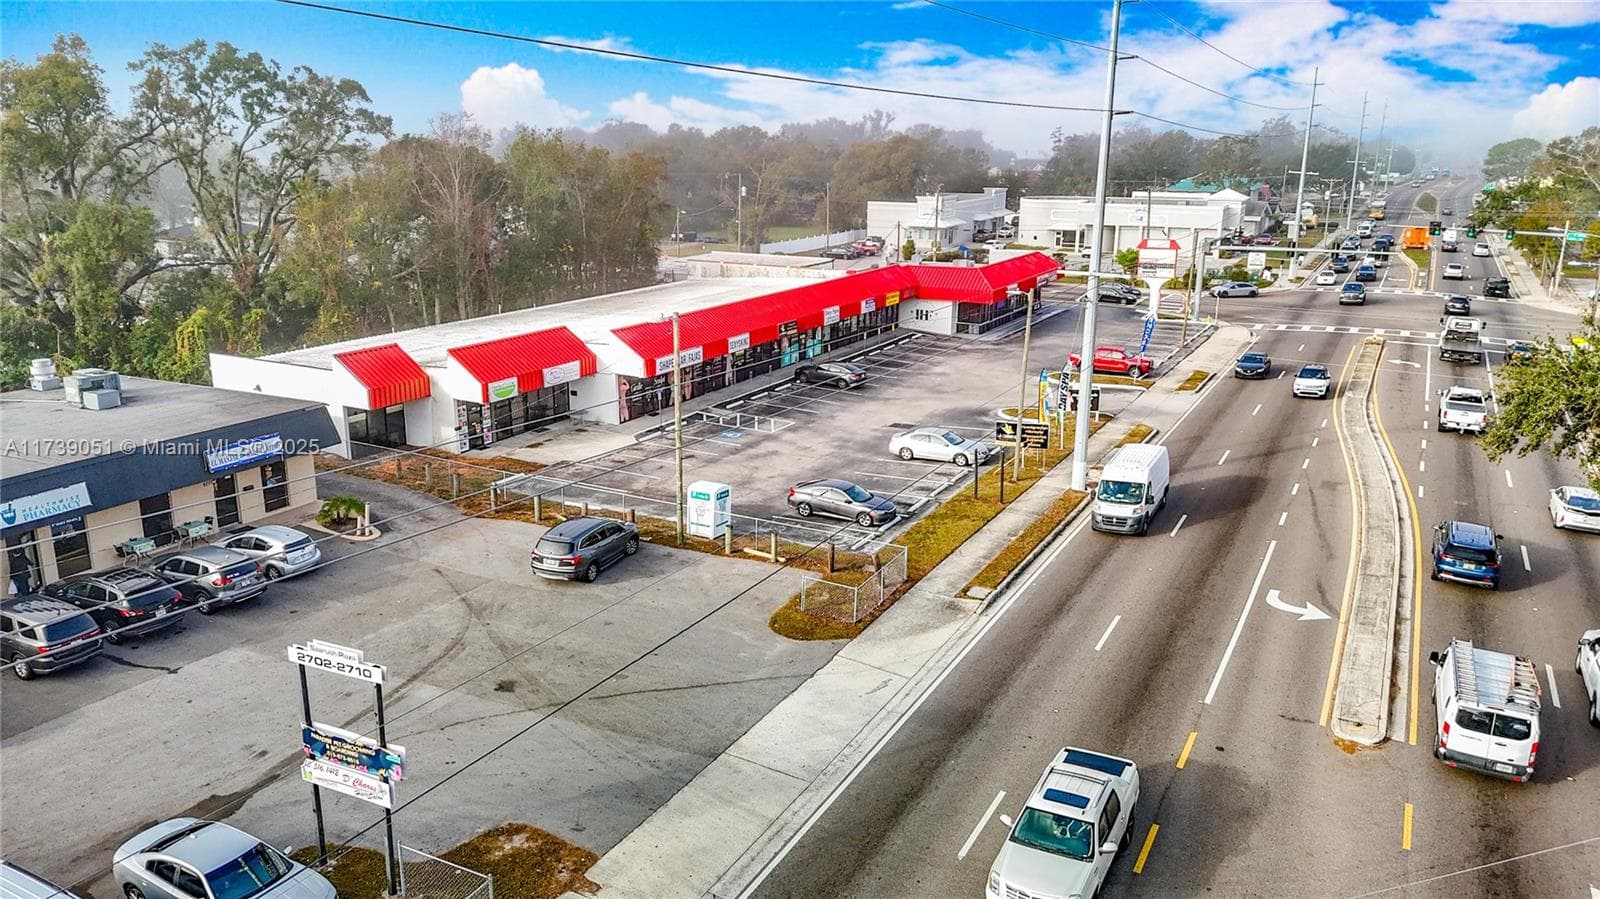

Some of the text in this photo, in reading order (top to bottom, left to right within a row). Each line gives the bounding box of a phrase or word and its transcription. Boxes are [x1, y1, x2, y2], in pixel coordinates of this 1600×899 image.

[1061, 372, 1070, 391] SPA
[21, 494, 80, 512] HEALTHWISE
[23, 498, 82, 521] PHARMACY
[296, 651, 372, 679] 2702-2710
